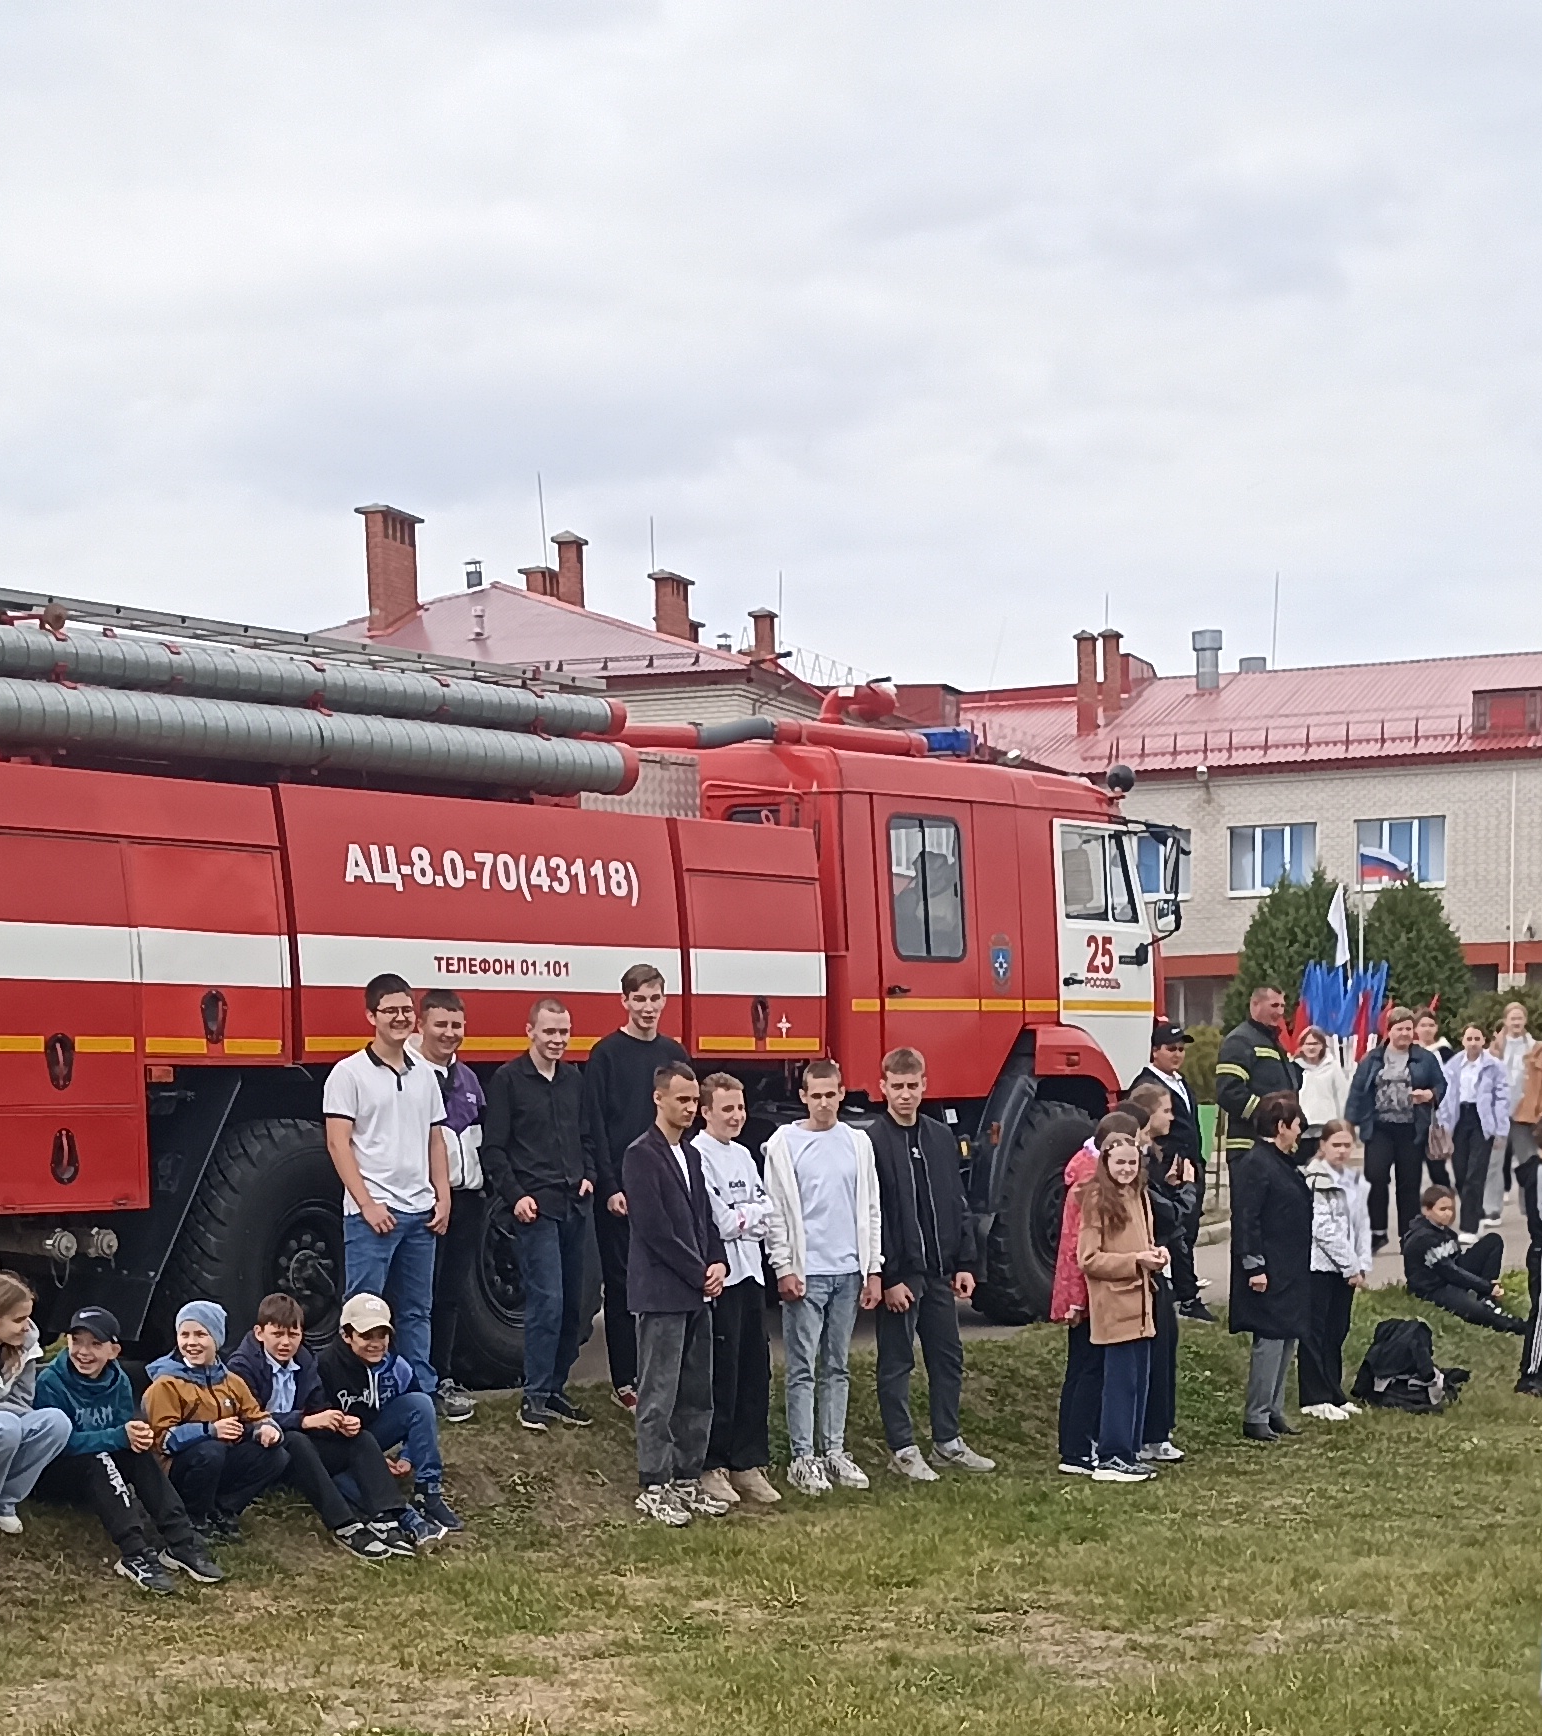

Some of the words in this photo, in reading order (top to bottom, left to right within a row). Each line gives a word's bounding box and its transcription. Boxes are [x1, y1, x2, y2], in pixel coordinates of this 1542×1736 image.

[344, 842, 639, 907] АЦ-8.0-70(43118)
[433, 955, 515, 975] ТЕЛЕФОН
[520, 958, 570, 978] 01.101
[1086, 934, 1114, 975] 25
[1084, 976, 1121, 990] РОССОШЬ
